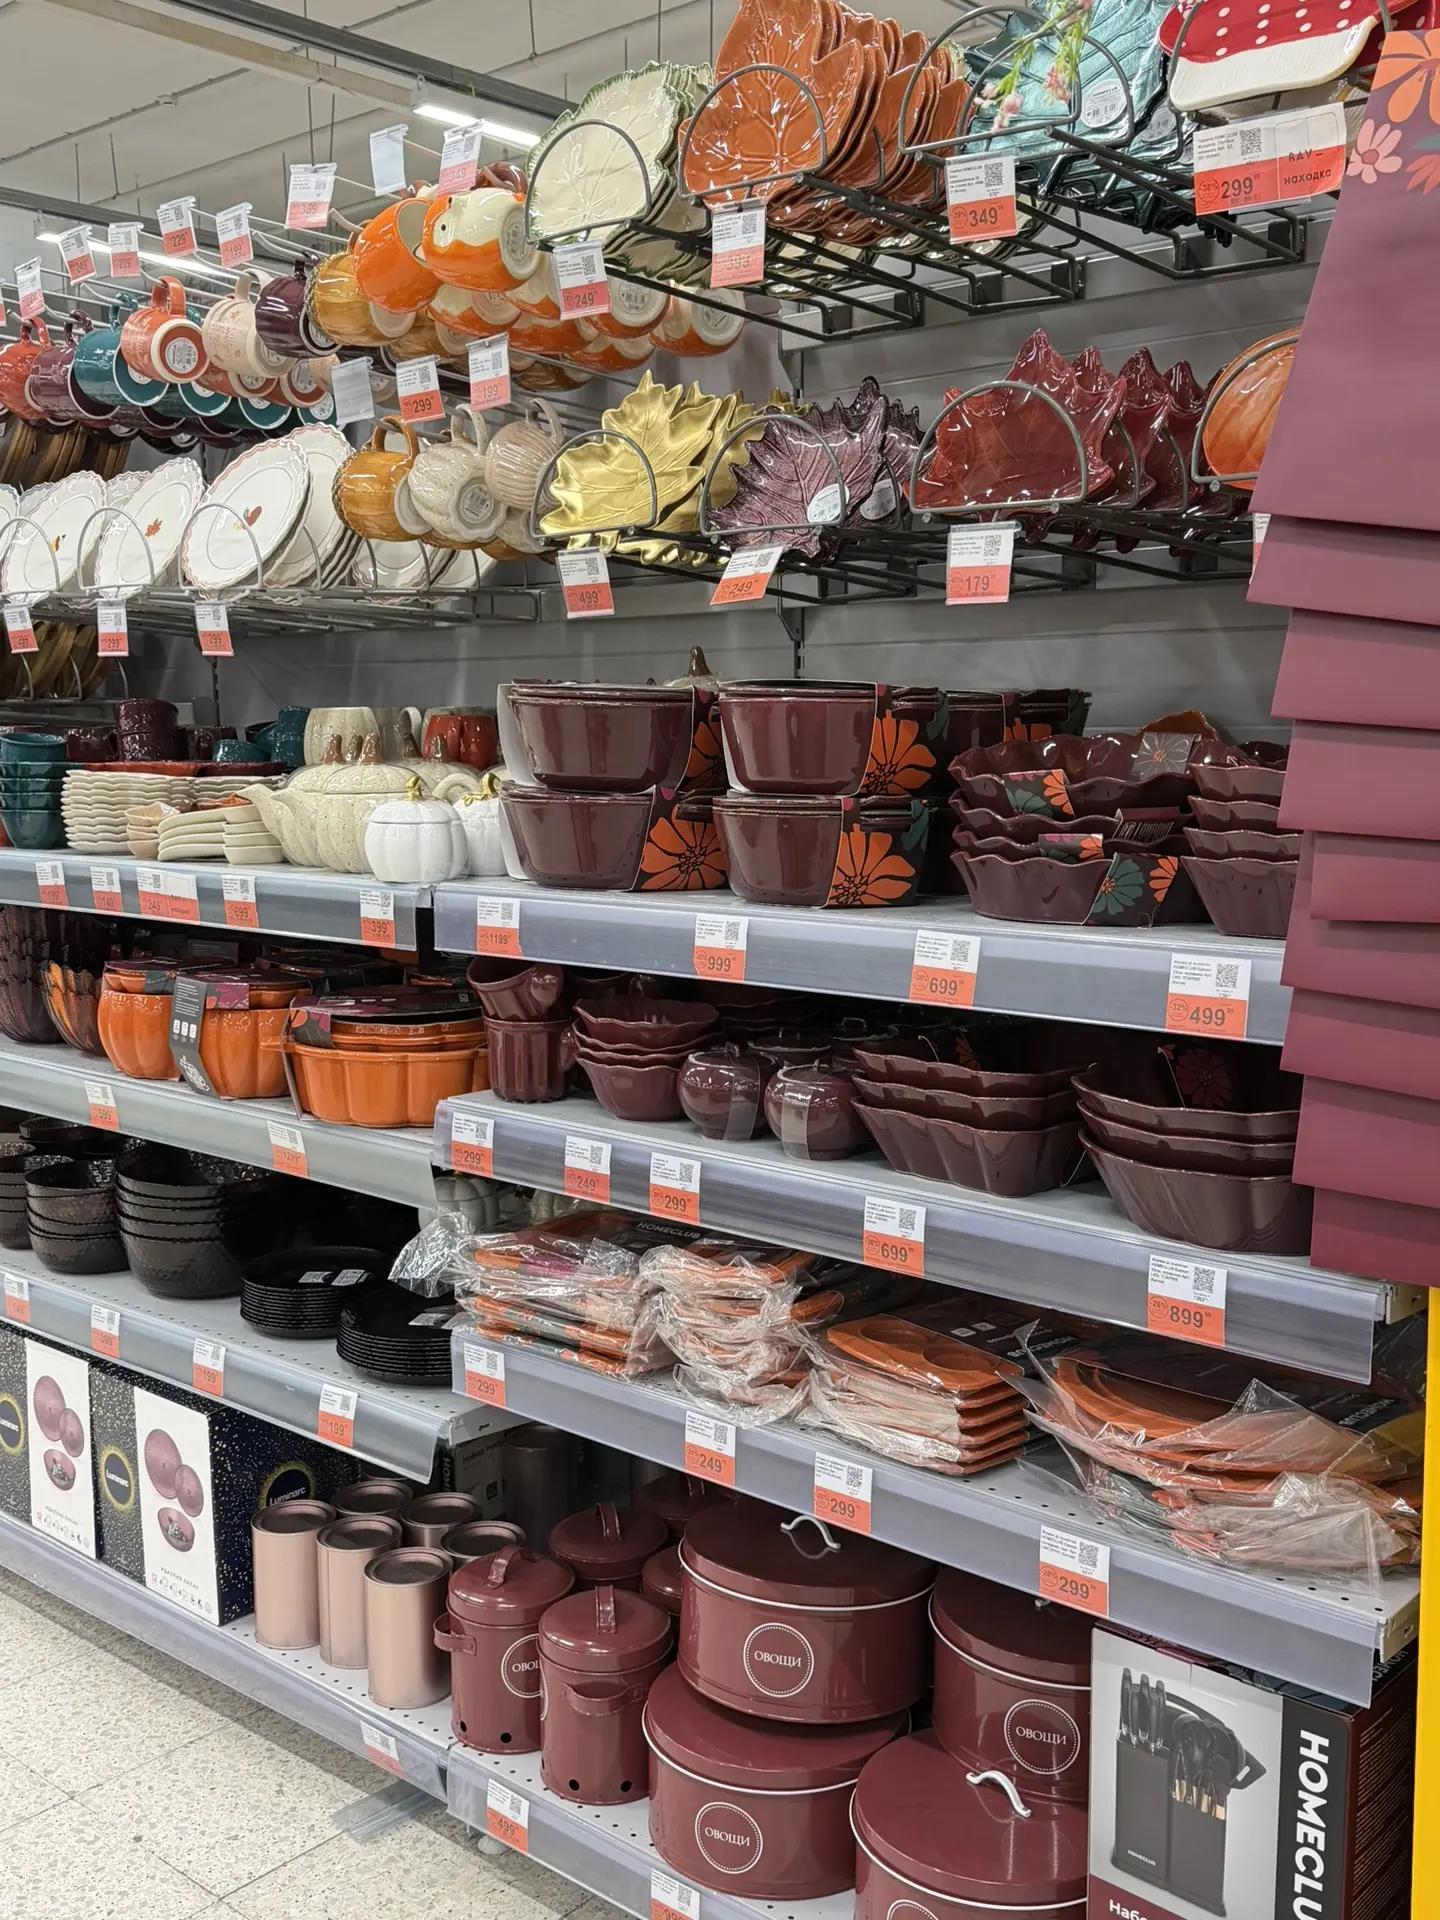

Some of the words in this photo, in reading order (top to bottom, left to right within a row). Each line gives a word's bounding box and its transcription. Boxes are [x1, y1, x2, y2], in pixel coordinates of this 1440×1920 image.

[1283, 169, 1332, 186] находка
[1221, 176, 1253, 200] 299
[969, 207, 998, 228] 349
[574, 293, 595, 308] 249
[413, 398, 432, 414] 299
[728, 580, 751, 595] 249
[965, 575, 990, 592] 179
[579, 591, 599, 605] 499
[234, 906, 248, 918] 699
[371, 920, 387, 934] 399
[489, 934, 508, 945] 1199
[707, 955, 731, 972] 999
[929, 977, 958, 996] 699
[1189, 1006, 1226, 1027] 499
[463, 1151, 481, 1165] 299
[576, 1175, 596, 1192] 249
[664, 1195, 687, 1213] 299
[636, 1221, 702, 1240] HOMECLUB
[881, 1242, 908, 1263] 699
[1169, 1305, 1204, 1329] 899
[202, 1370, 216, 1384] 199
[477, 1378, 495, 1396] 299
[329, 1420, 345, 1437] 199
[699, 1453, 722, 1473] 249
[106, 1469, 129, 1488] Luminarc
[269, 1486, 306, 1506] Luminarc
[830, 1498, 855, 1519] 299
[1058, 1575, 1090, 1600] 299
[754, 1650, 802, 1668] ОВОЩИ
[1015, 1726, 1067, 1746] ОВОЩИ
[497, 1818, 516, 1836] 499
[704, 1826, 751, 1847] ОВОЩИ
